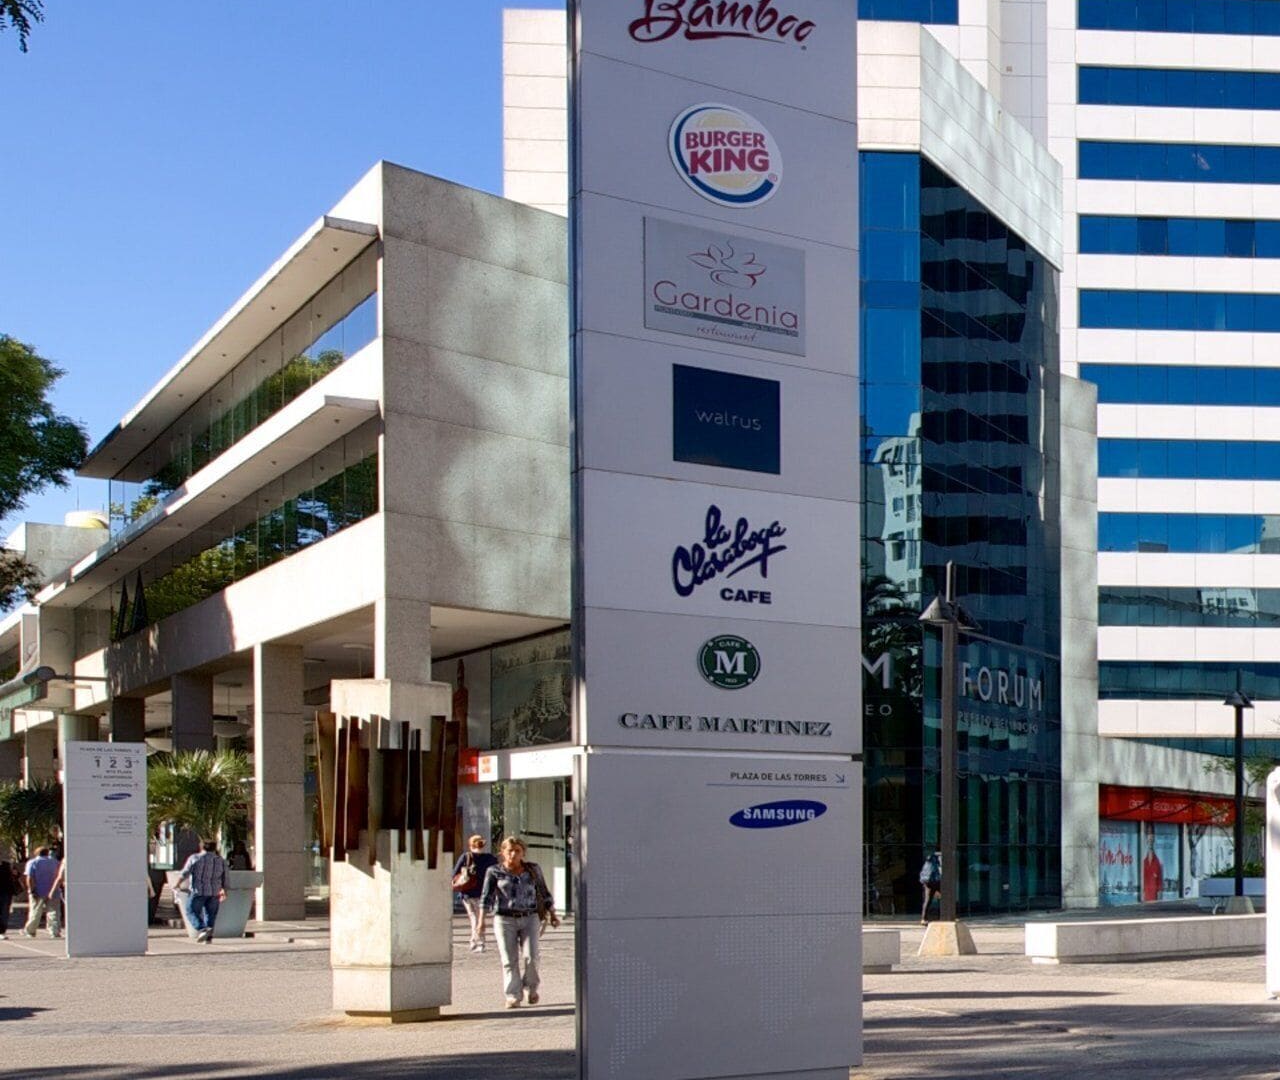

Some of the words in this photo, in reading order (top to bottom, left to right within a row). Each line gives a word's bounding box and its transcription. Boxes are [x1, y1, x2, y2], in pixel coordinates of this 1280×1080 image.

[685, 131, 766, 151] BURGER
[688, 149, 770, 176] KING
[653, 280, 798, 330] Gardenia
[695, 408, 762, 431] walrus
[720, 587, 772, 605] CAFE
[713, 650, 748, 675] M
[961, 662, 1042, 712] FORUM
[618, 712, 692, 731] CAFE
[698, 716, 833, 737] MARTINEZ
[110, 759, 117, 768] 2
[125, 759, 132, 768] 3
[730, 772, 760, 781] PLAZA
[761, 772, 773, 781] DE
[775, 773, 792, 781] LAS
[794, 773, 828, 782] TORRES
[743, 807, 816, 821] SAMSUNG
